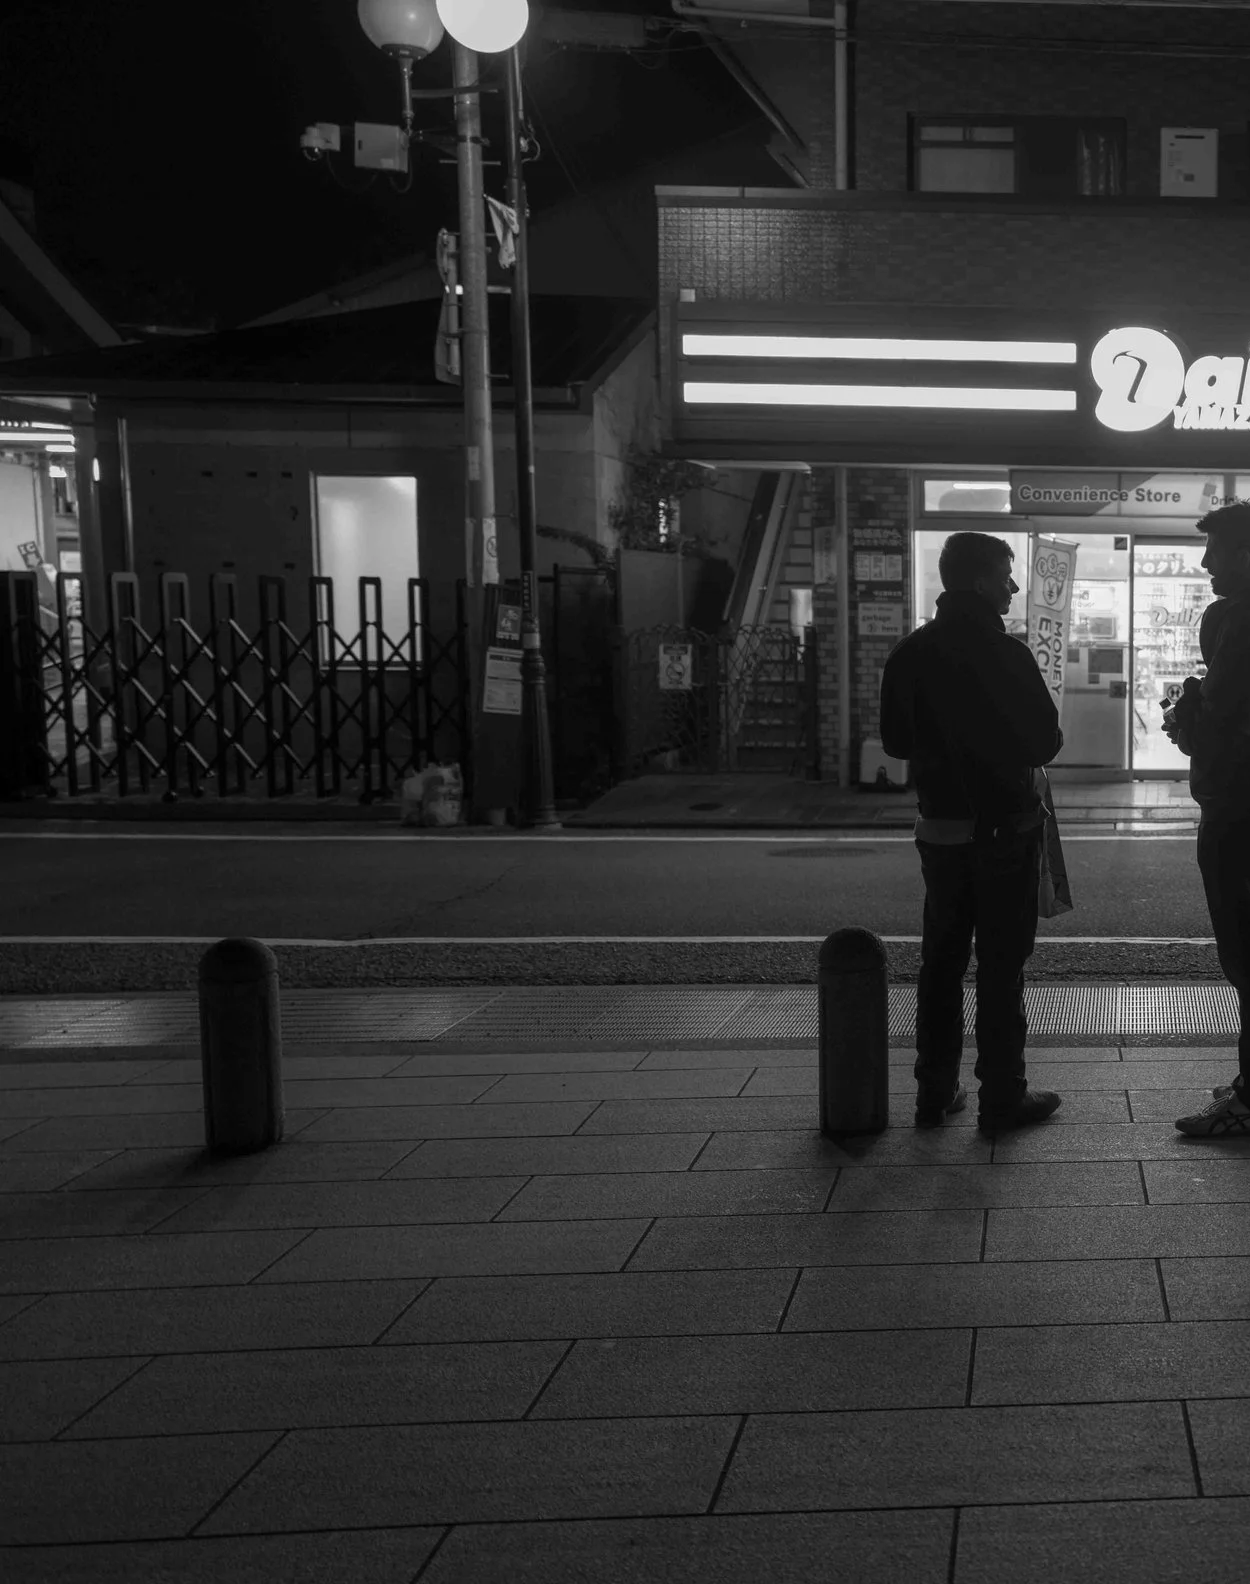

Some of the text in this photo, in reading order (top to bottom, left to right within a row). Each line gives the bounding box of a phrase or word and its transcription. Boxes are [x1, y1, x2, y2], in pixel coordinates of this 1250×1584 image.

[1018, 485, 1181, 503] Convenience Store
[1051, 621, 1063, 696] MONEY
